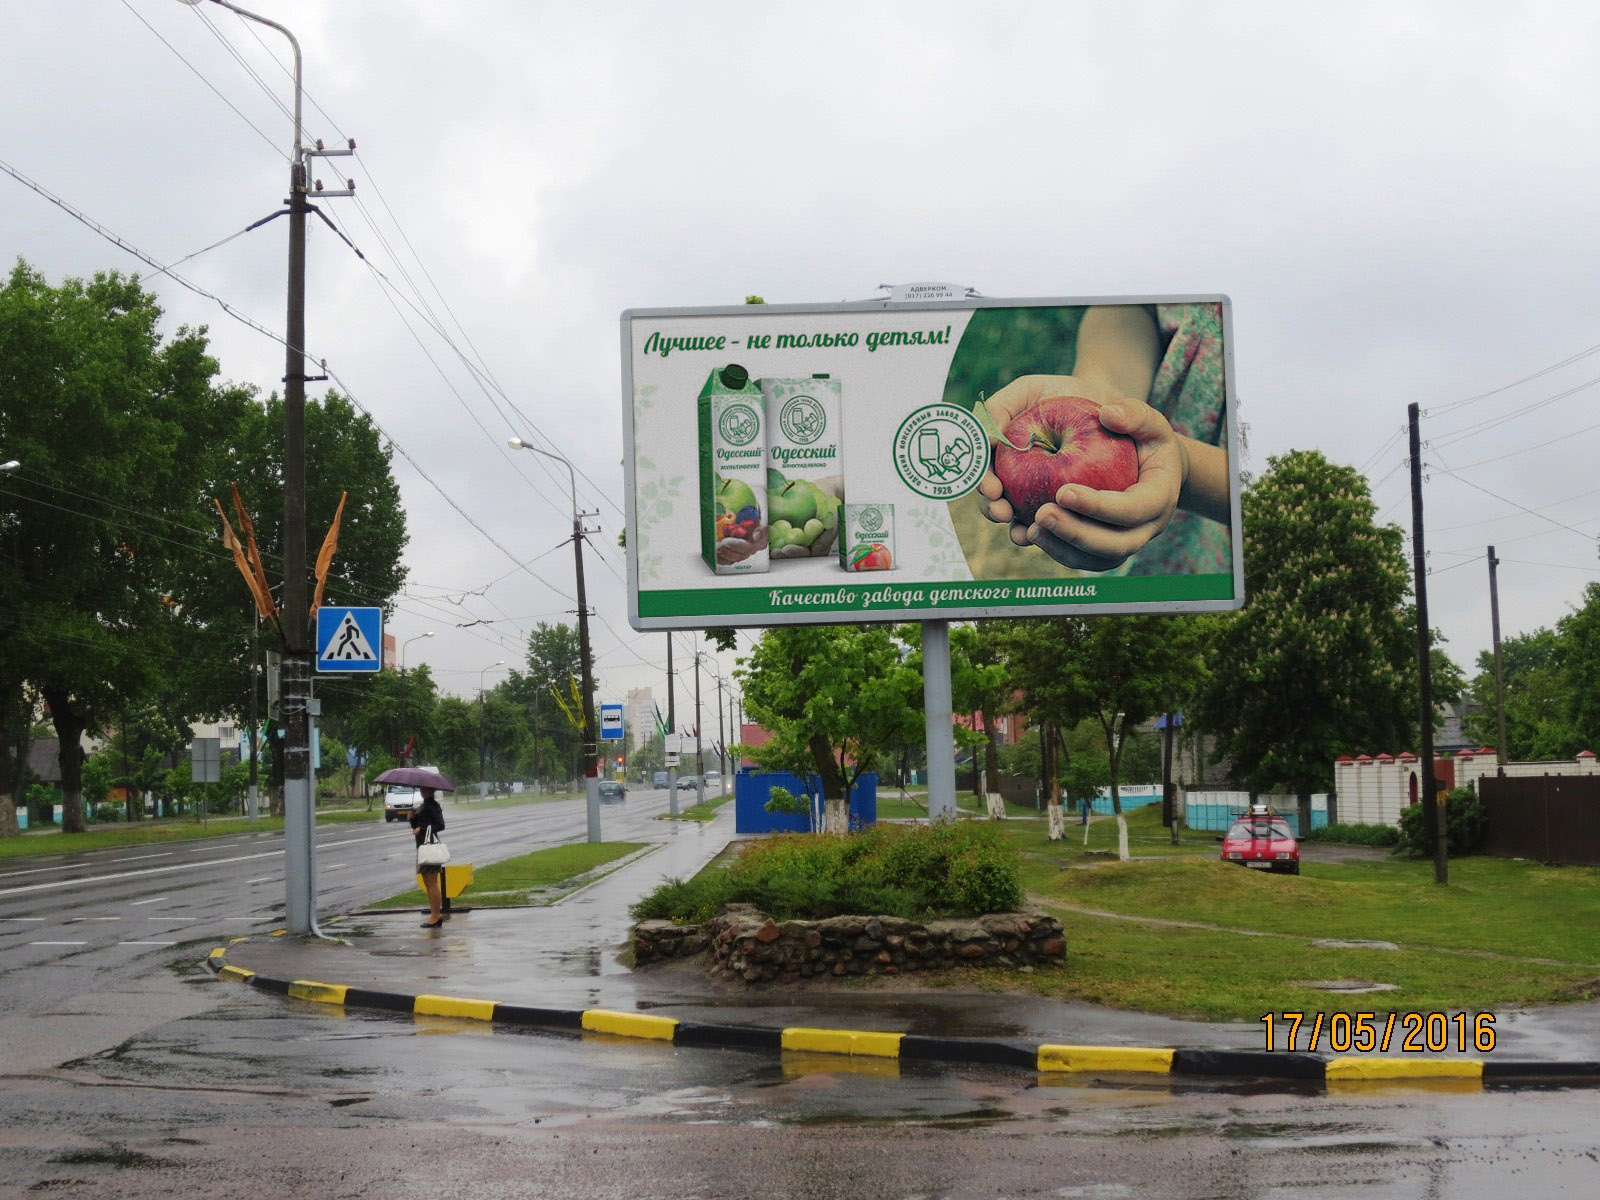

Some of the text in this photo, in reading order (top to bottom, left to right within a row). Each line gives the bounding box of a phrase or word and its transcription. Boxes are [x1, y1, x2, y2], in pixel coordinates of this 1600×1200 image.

[644, 331, 727, 357] Лучшее
[747, 334, 772, 349] не
[775, 332, 859, 349] только
[866, 325, 951, 352] детям!
[717, 447, 763, 461] Одесский
[771, 444, 837, 463] Одесский
[898, 409, 983, 486] ОДЕССКИЙ КОНСЕРВНЫЙ ЗАВОД ДЕТСКОГО ПИТАНИЯ
[932, 486, 953, 495] 1928
[768, 584, 1097, 608] Качество завода детского питания
